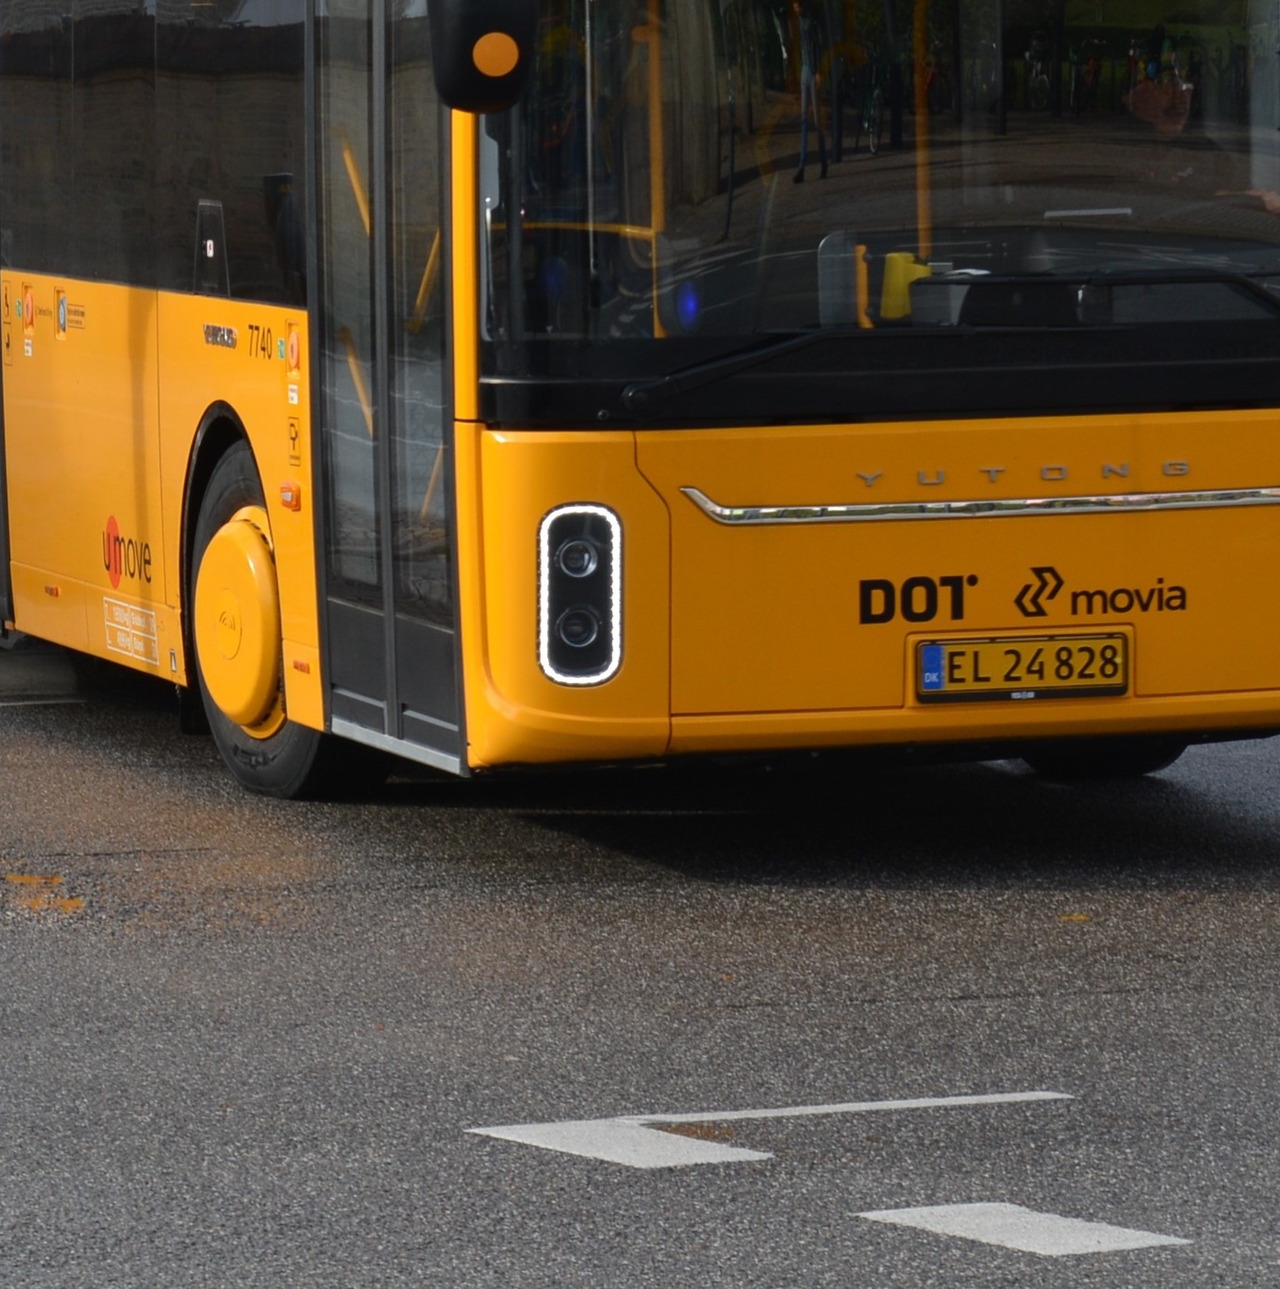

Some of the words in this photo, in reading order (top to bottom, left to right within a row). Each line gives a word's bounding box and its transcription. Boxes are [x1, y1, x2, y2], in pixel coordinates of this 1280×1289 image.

[248, 324, 272, 360] 7740
[856, 460, 1190, 486] YUTONG
[859, 574, 979, 625] DOT
[1070, 578, 1187, 616] movia
[924, 672, 939, 683] DK
[948, 650, 991, 684] EL
[1003, 647, 1045, 682] 24
[1054, 644, 1119, 681] 828
